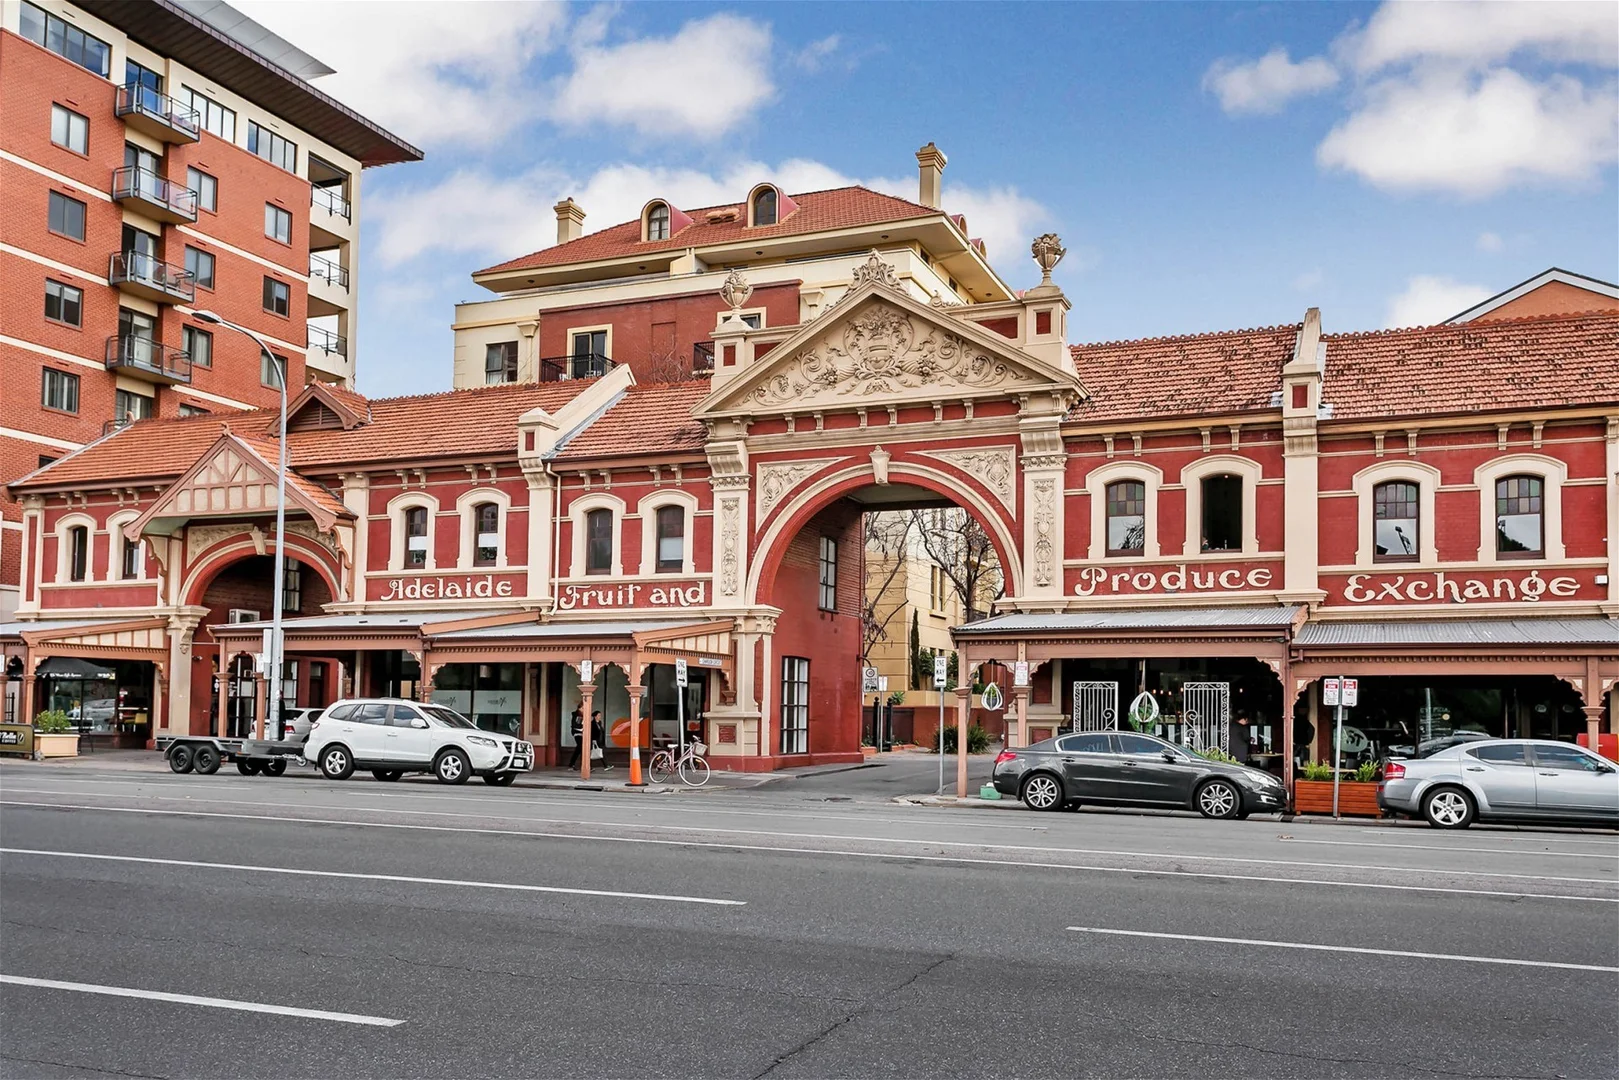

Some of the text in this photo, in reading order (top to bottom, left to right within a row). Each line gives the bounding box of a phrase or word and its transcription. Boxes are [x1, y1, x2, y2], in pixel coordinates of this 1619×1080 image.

[381, 575, 512, 601] Adelaide
[560, 581, 706, 610] Fruit and
[1074, 564, 1273, 597] Produce
[1343, 569, 1581, 603] Exchange
